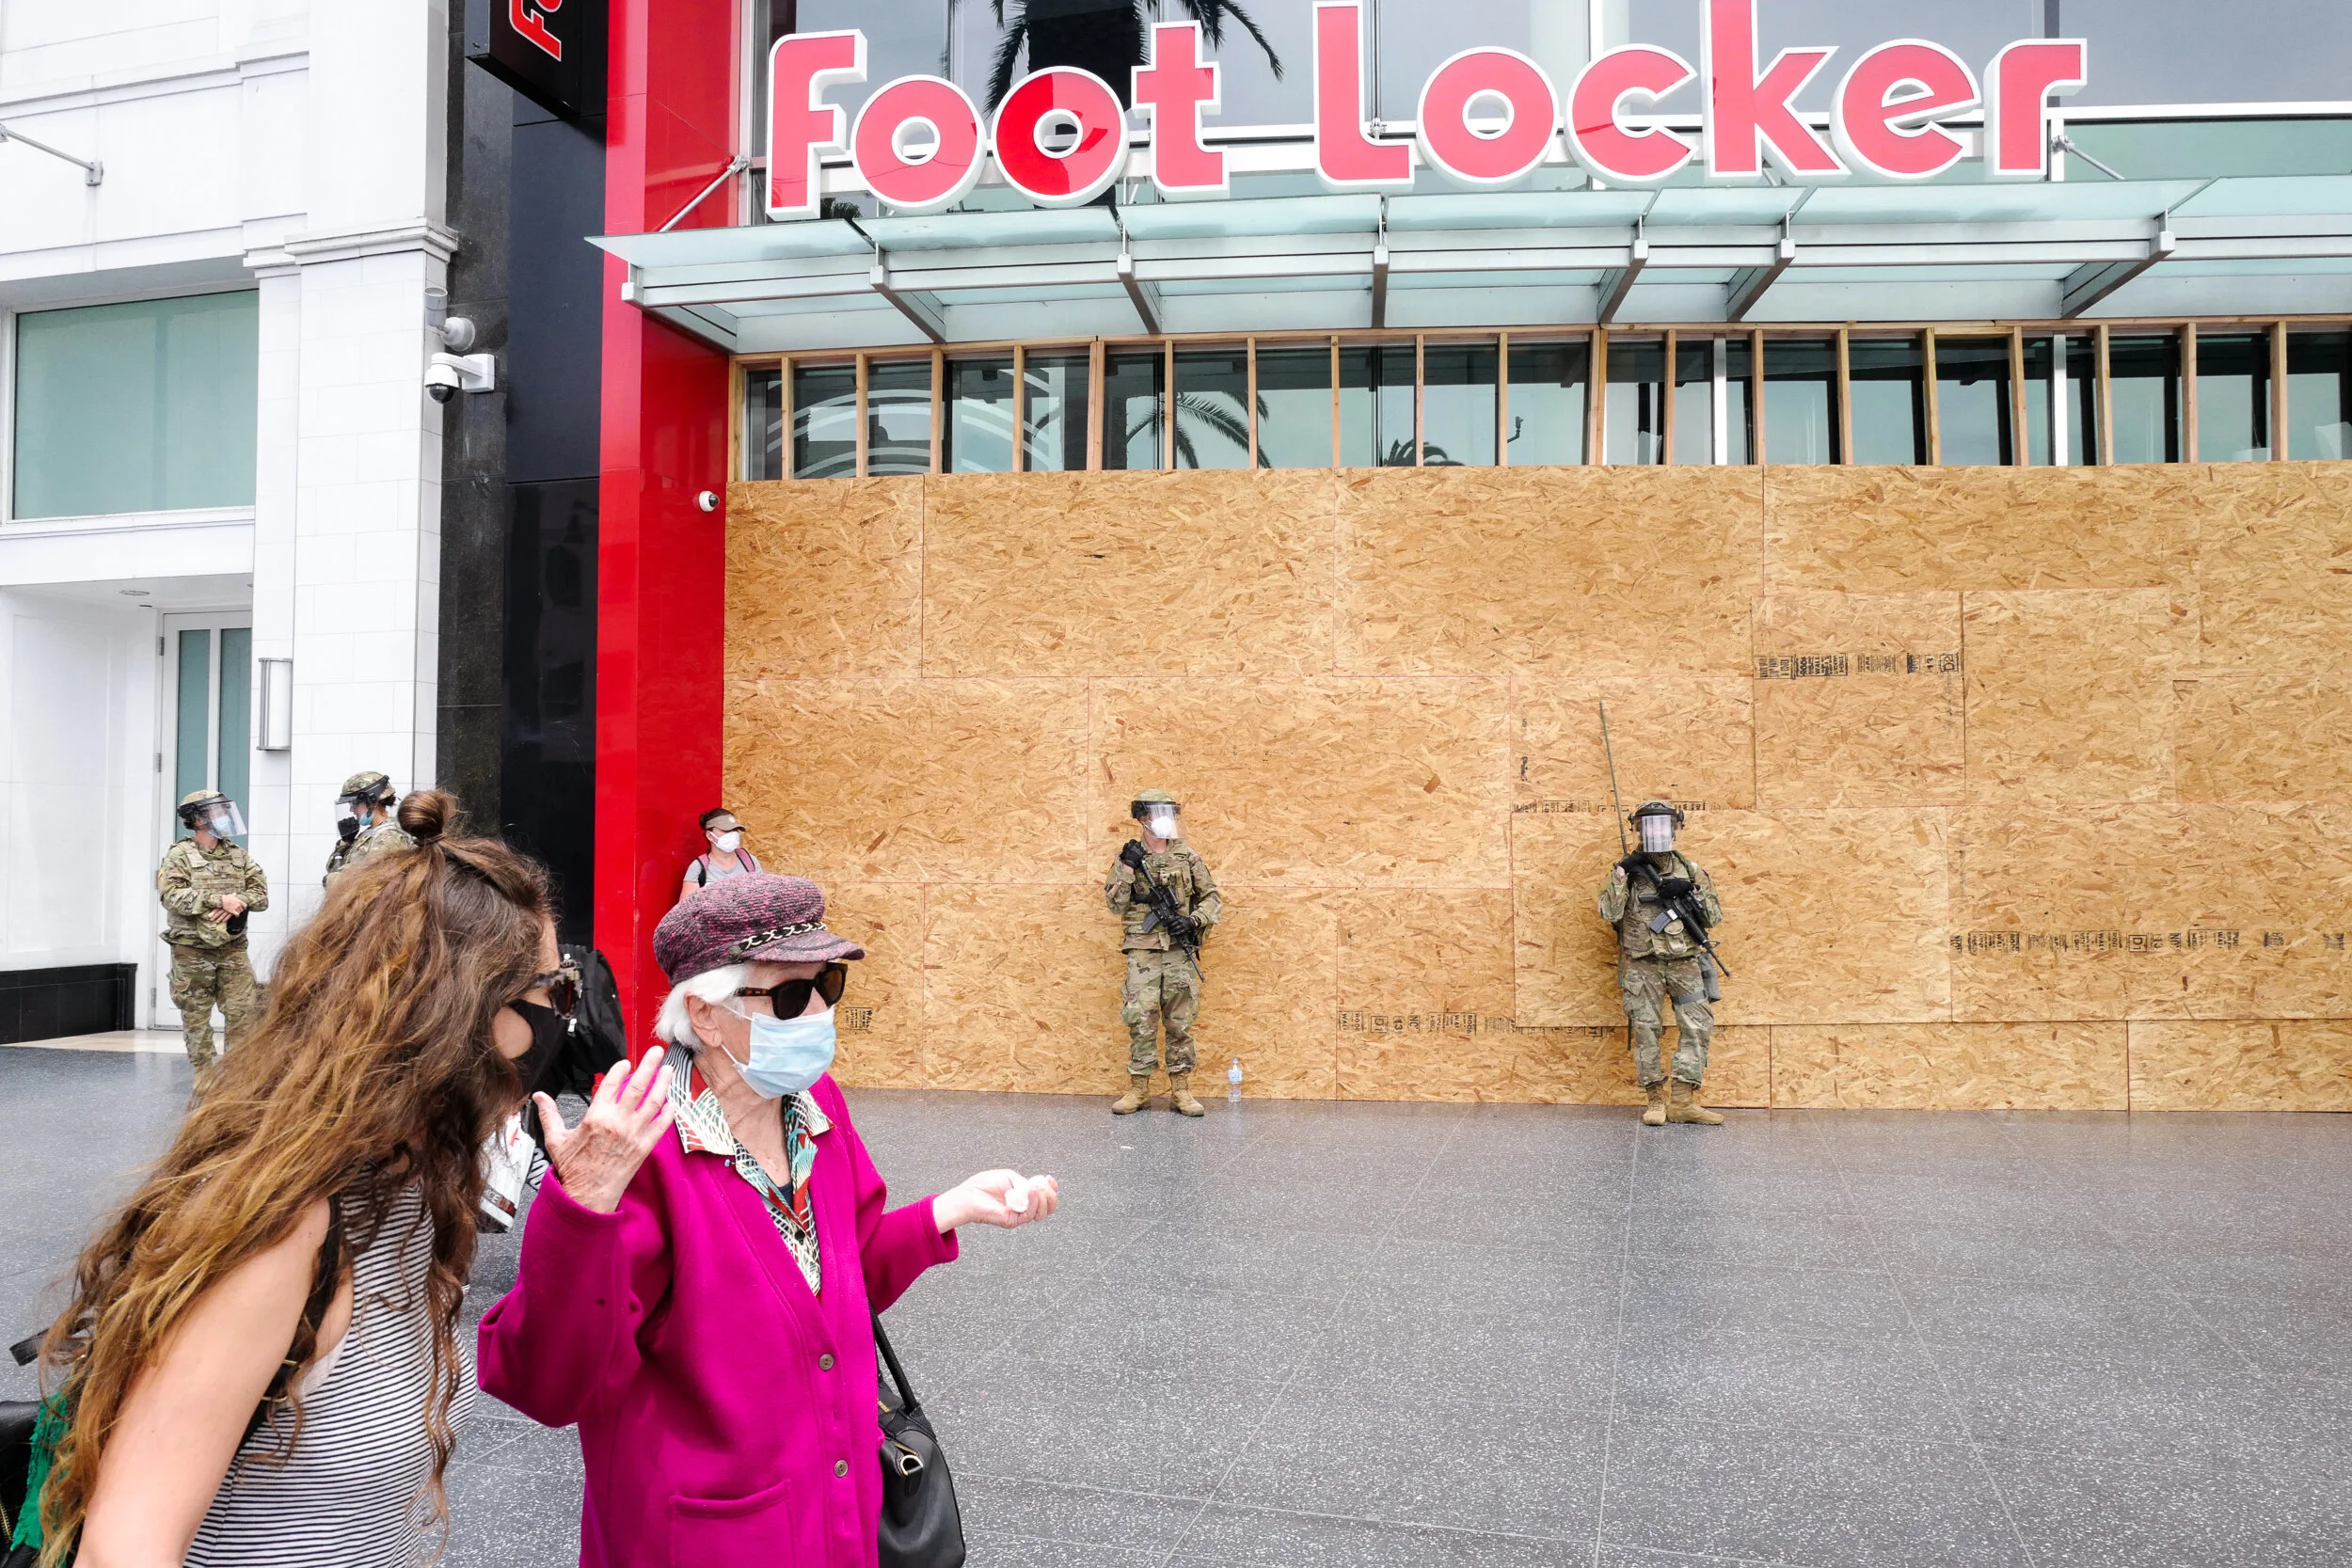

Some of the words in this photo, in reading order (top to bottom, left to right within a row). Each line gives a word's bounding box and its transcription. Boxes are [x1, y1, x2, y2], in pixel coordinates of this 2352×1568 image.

[1312, 0, 2089, 188] Locker
[1943, 656, 1955, 671] D2
[2132, 937, 2143, 950] D1
[1374, 1018, 1384, 1032] D1
